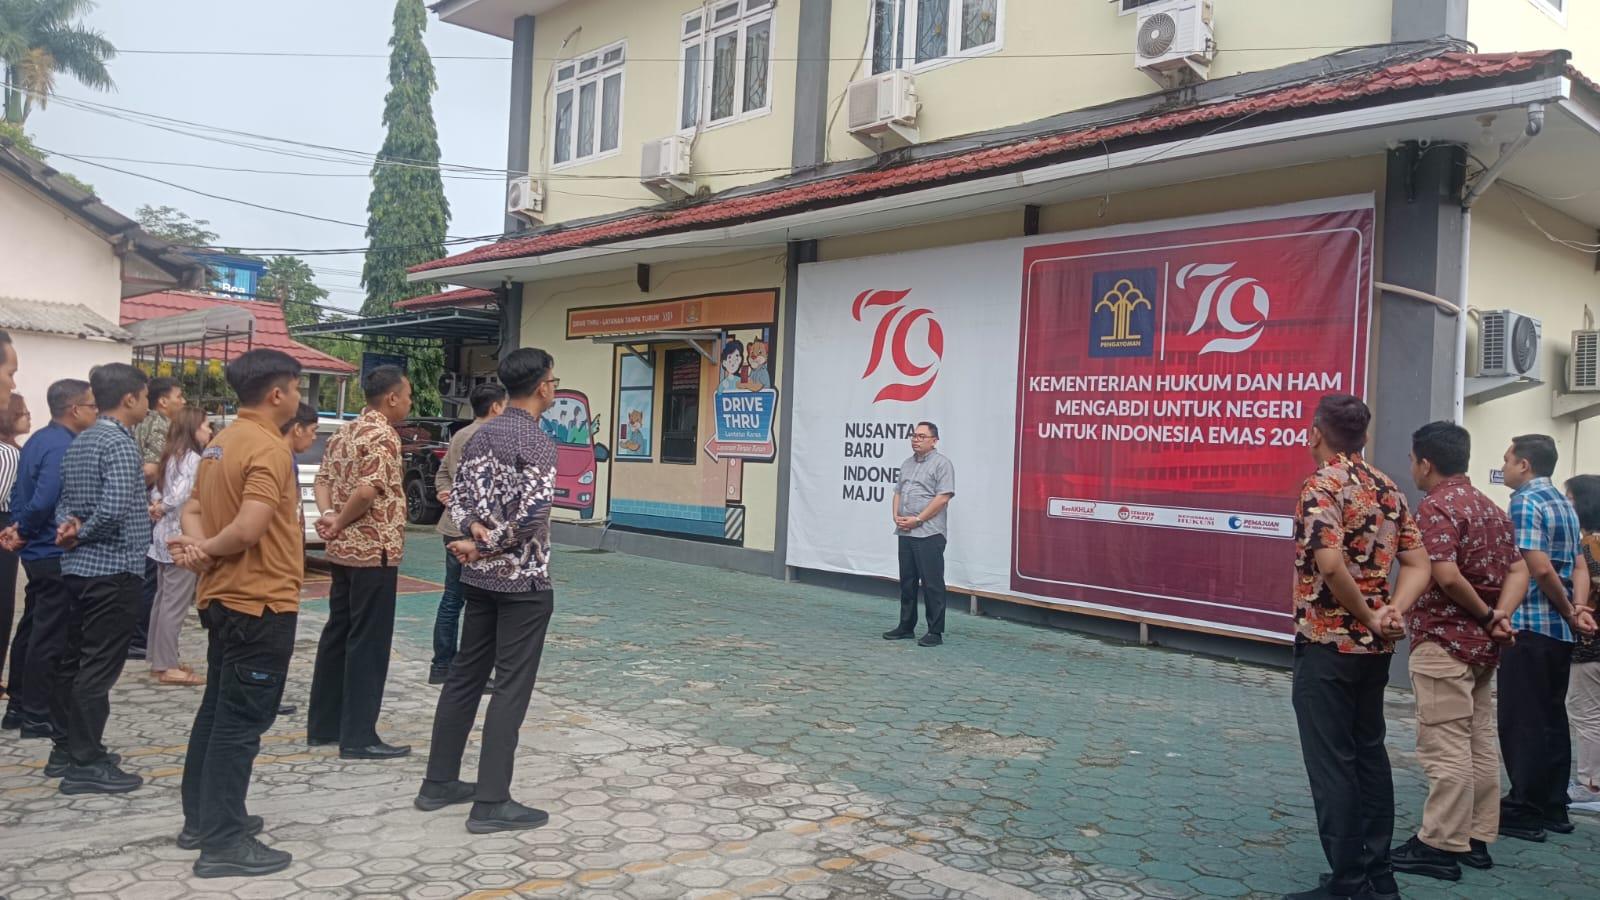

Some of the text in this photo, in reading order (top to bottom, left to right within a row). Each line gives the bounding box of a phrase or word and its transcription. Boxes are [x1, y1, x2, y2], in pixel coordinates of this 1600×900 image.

[1029, 372, 1342, 392] KEMENTERIAN HUKUM DAN HAM
[722, 396, 763, 412] DRIVE
[1055, 400, 1302, 419] MENGABDI UNTUK NEGERI
[723, 413, 760, 429] THRU
[845, 422, 915, 440] NUSANTA
[1038, 423, 1311, 447] UNTUK INDONESIA EMAS 204
[844, 442, 884, 459] BARU
[843, 465, 901, 484] INDONE
[842, 484, 885, 503] MAJU
